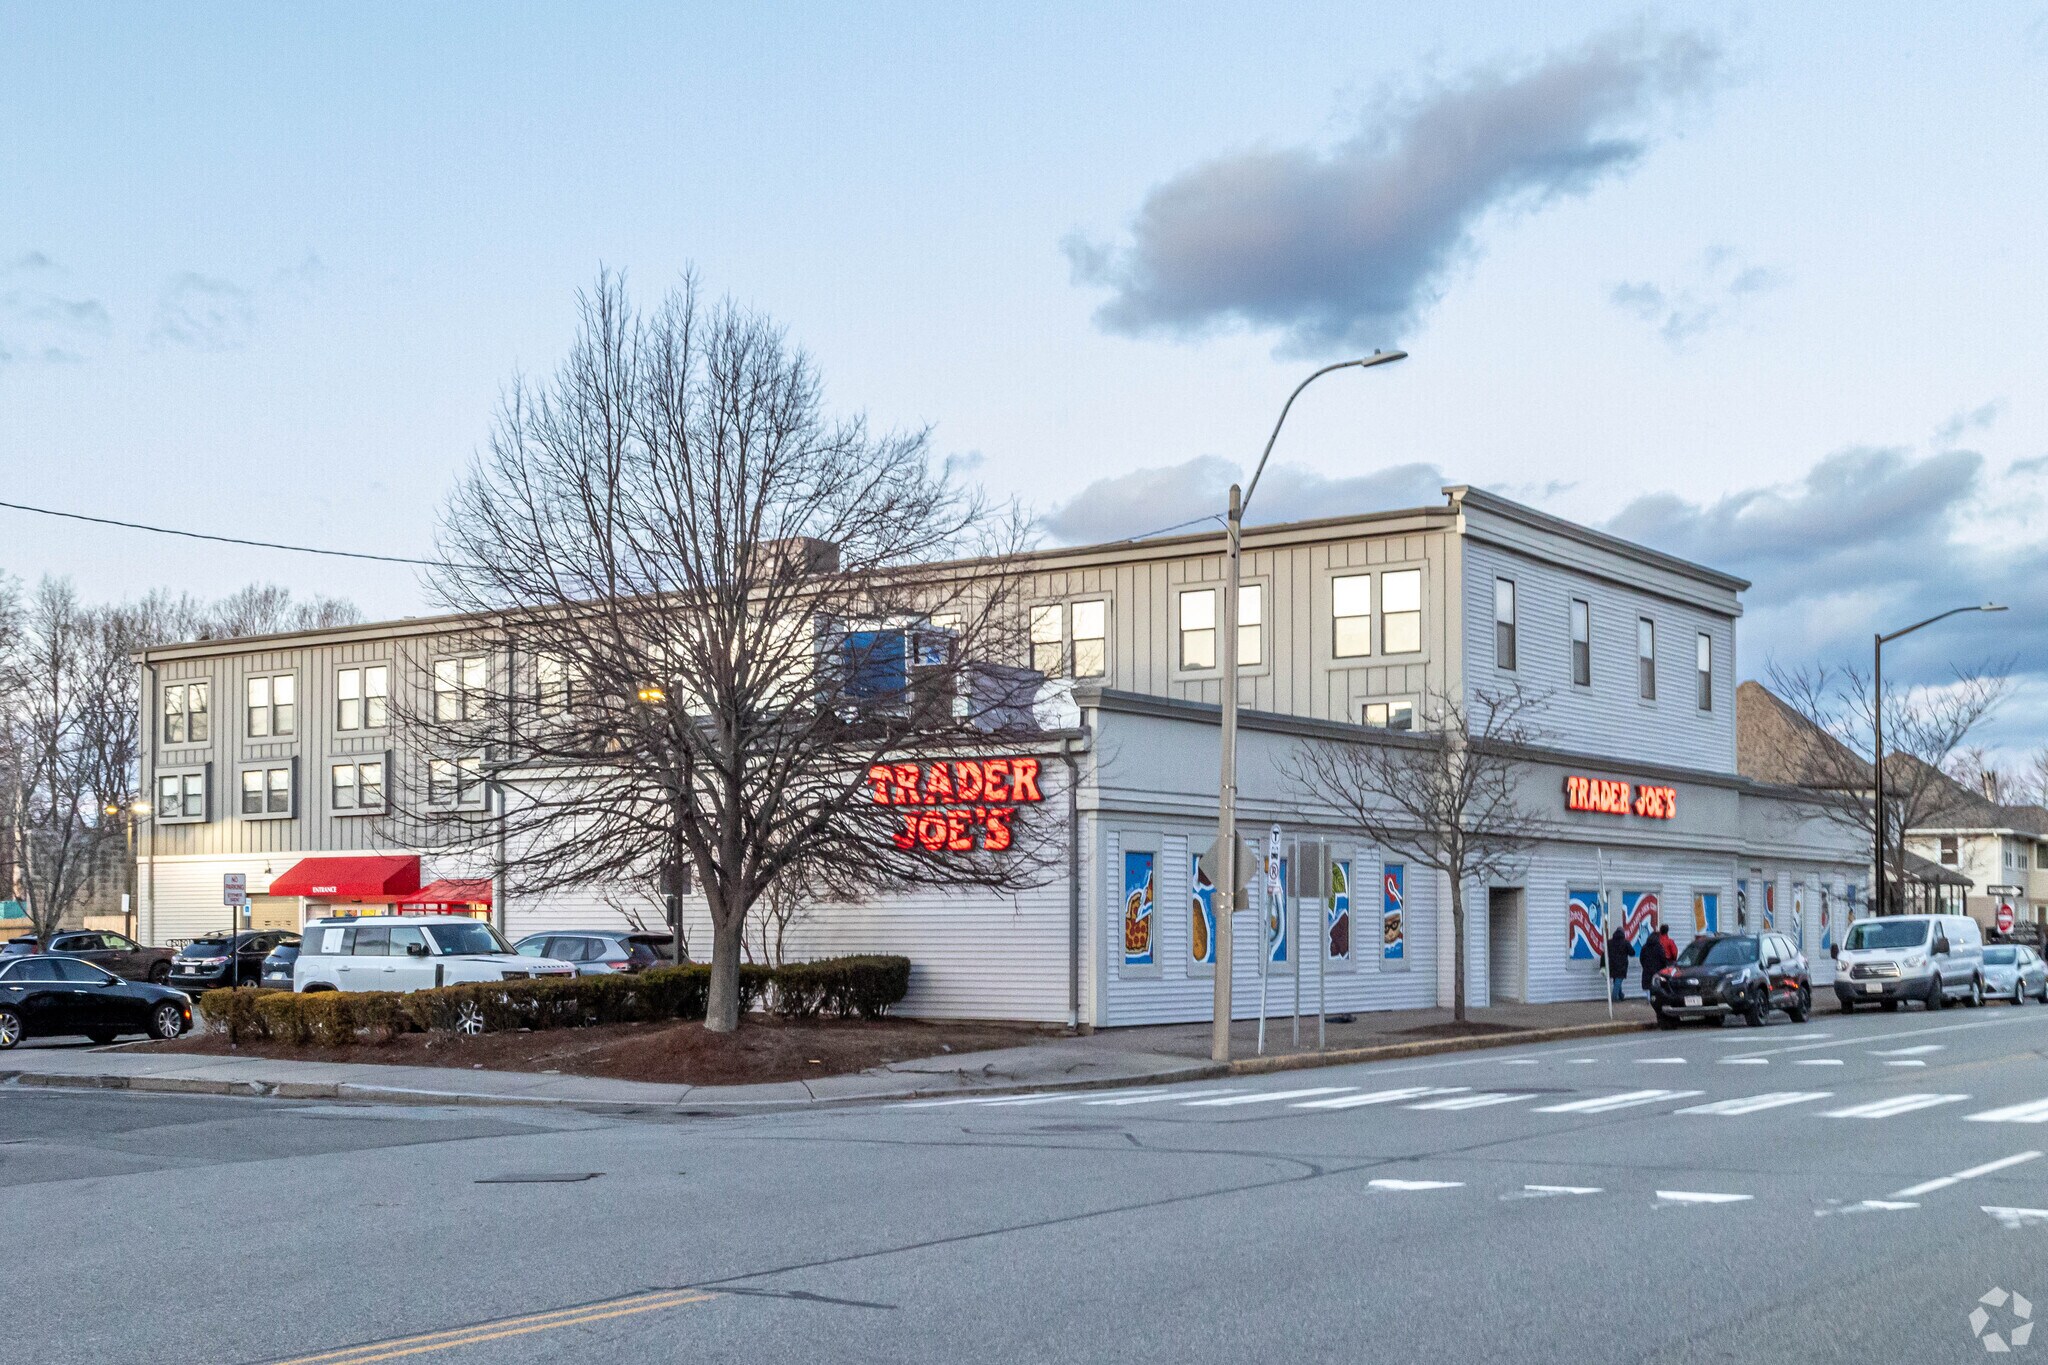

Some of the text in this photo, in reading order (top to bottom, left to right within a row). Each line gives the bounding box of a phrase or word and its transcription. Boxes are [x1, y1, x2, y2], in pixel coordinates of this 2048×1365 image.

[868, 757, 1042, 805] TRADER
[1566, 776, 1677, 820] TRADER JOE'S
[892, 806, 1015, 852] JOE'S
